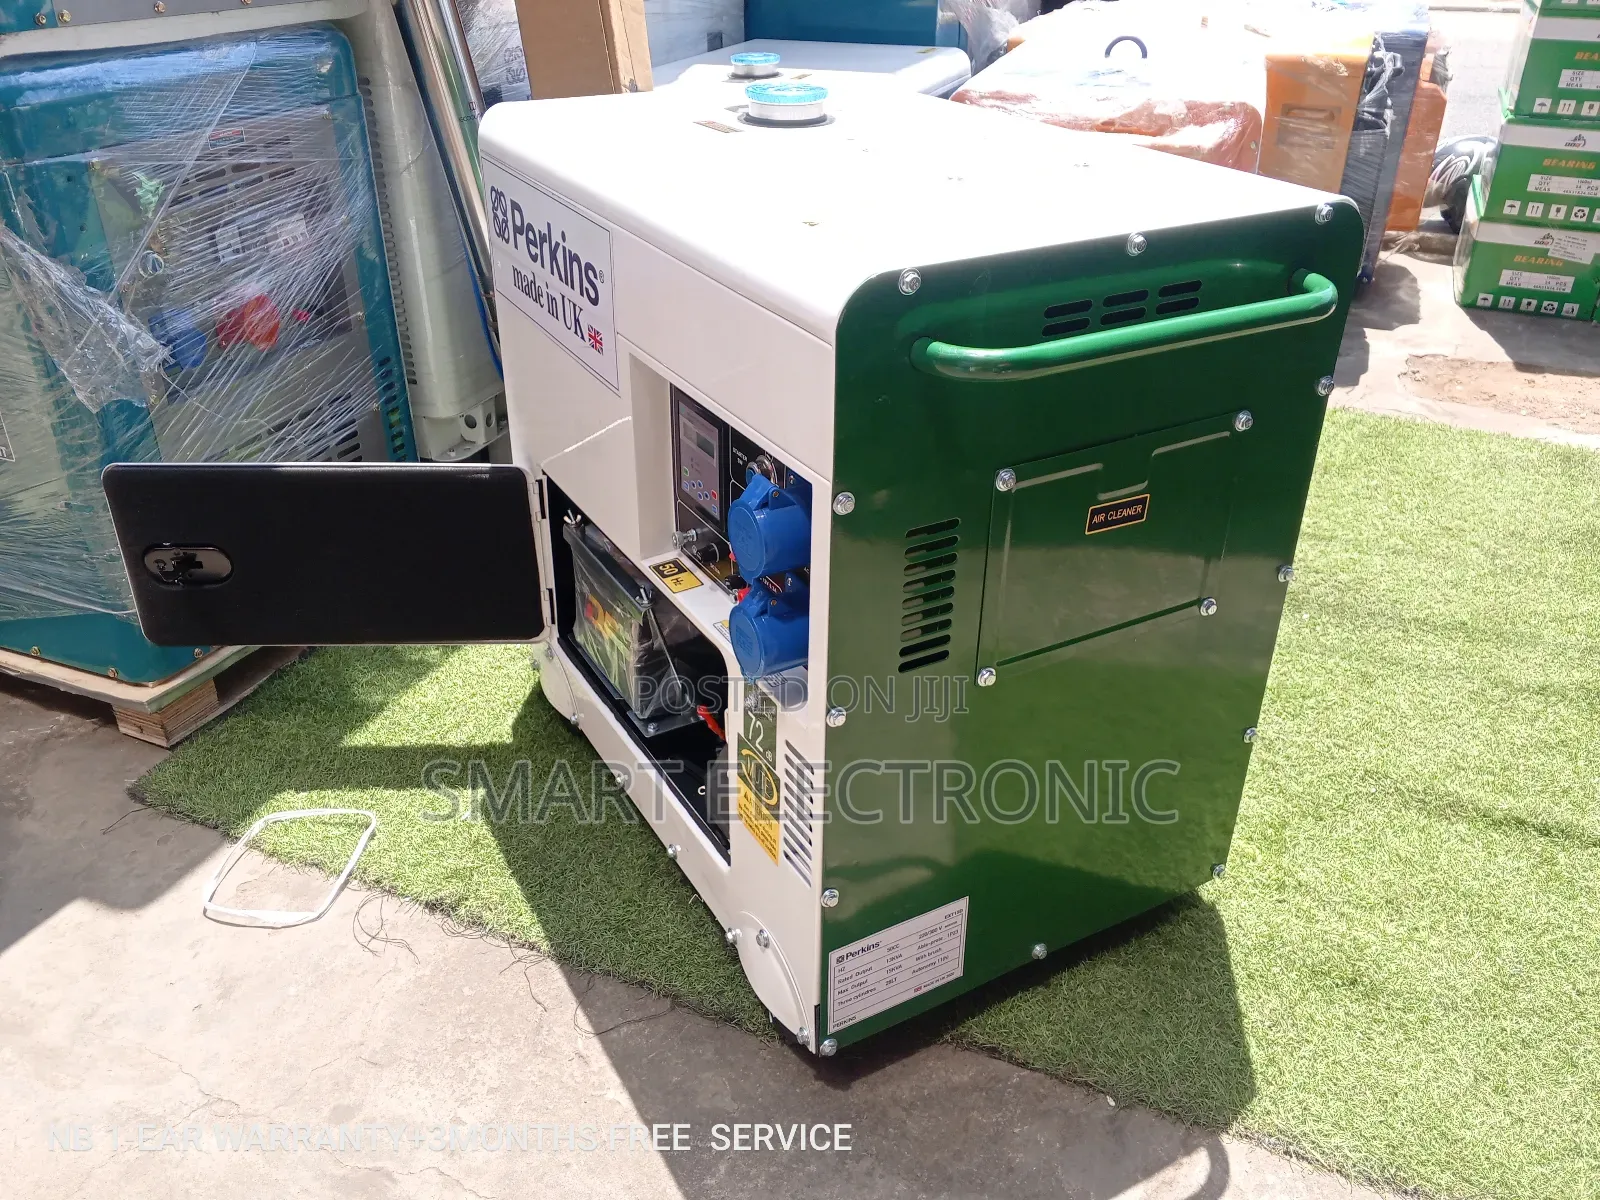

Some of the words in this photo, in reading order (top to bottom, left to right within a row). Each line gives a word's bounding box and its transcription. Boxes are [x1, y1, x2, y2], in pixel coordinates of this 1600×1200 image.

[1542, 158, 1596, 170] BEARING
[1513, 255, 1564, 267] BEARING
[511, 265, 545, 309] made
[545, 282, 560, 322] in
[559, 292, 586, 343] UK
[1091, 513, 1106, 524] AIR
[1107, 504, 1143, 521] CLEANER
[658, 563, 679, 576] 50
[747, 710, 764, 753] 72
[845, 941, 881, 960] Perkins
[854, 966, 873, 977] Output
[837, 988, 849, 996] Max
[832, 1015, 857, 1029] PERKINS
